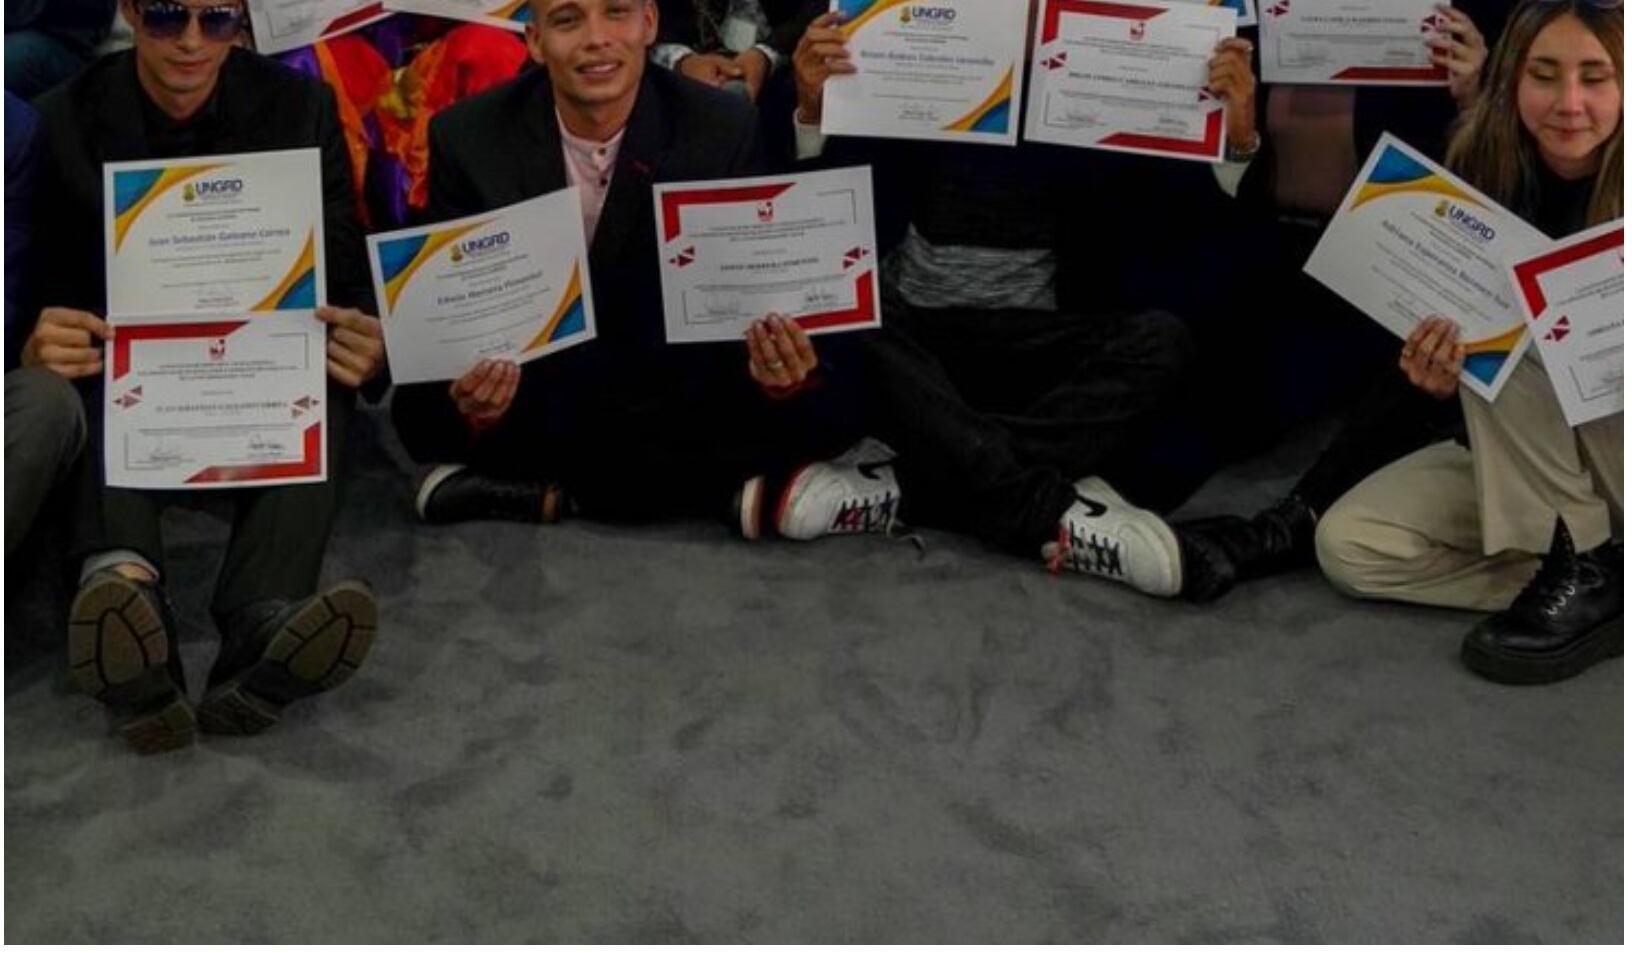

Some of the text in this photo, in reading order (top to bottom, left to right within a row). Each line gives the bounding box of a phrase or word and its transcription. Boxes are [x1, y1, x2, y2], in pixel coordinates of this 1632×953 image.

[912, 6, 956, 21] UNGRD
[196, 179, 243, 194] UNGRD
[1449, 205, 1496, 241] UNGRD
[462, 231, 511, 254] UNGRD
